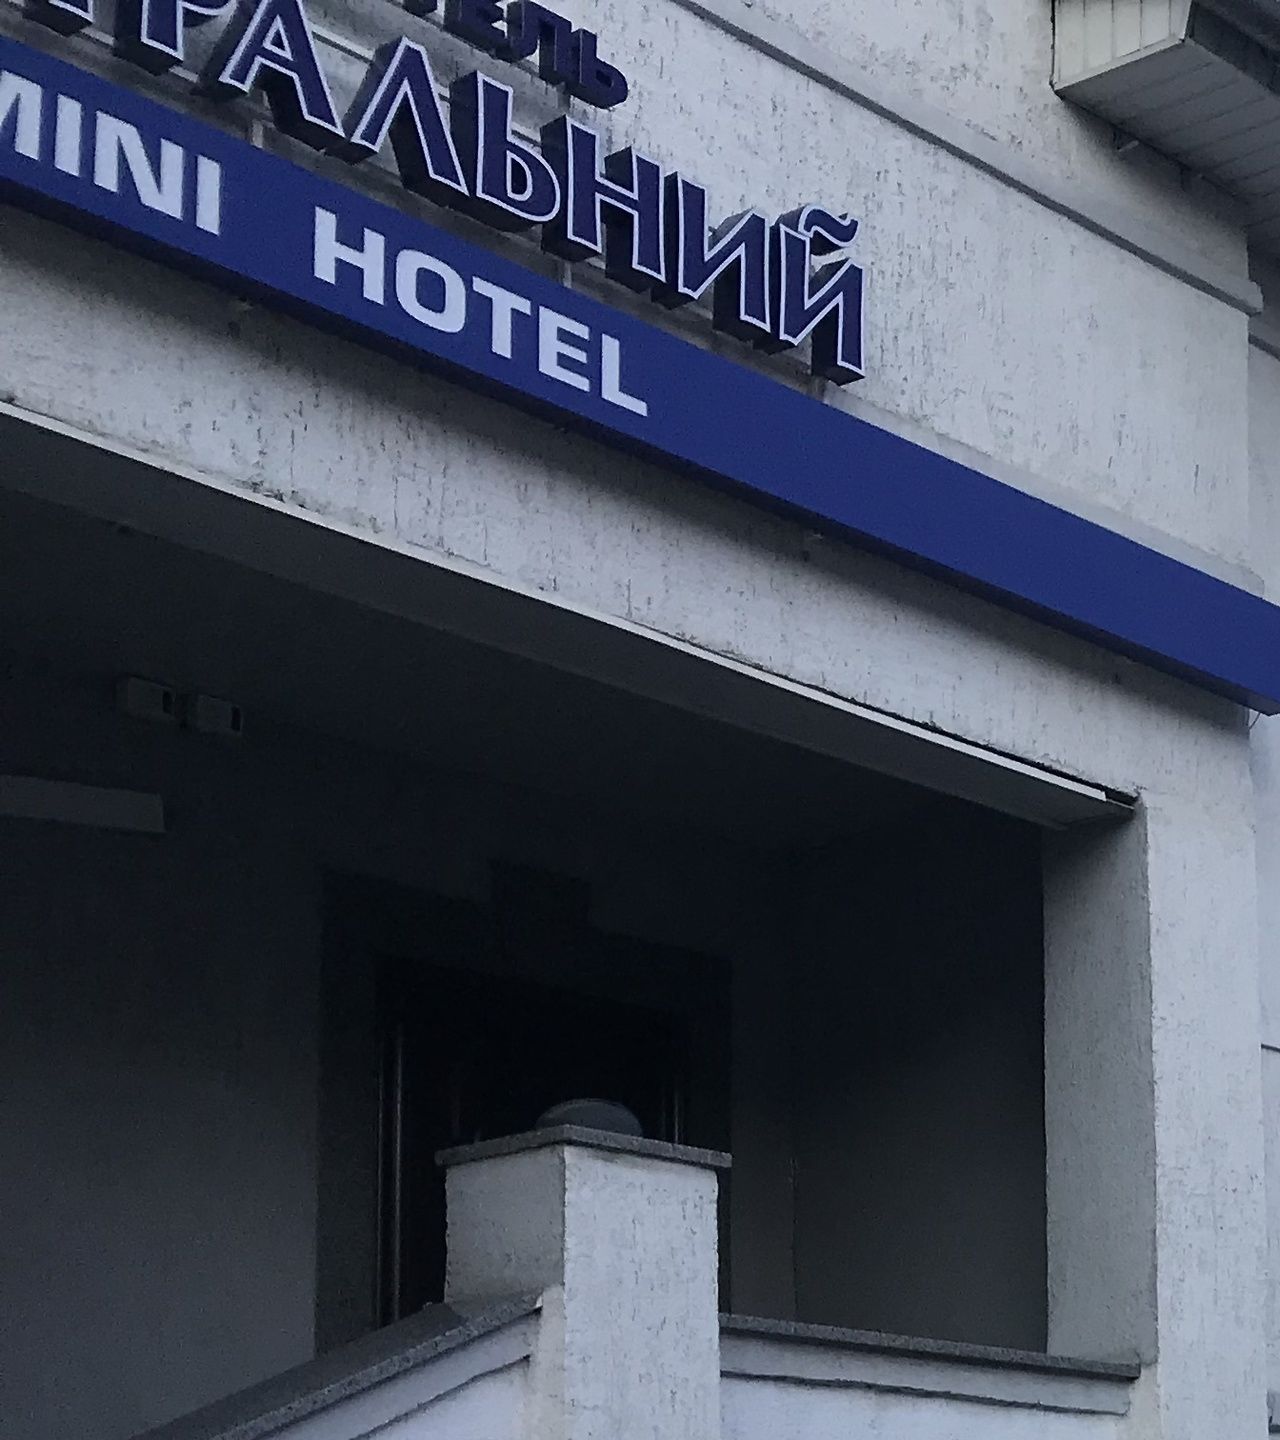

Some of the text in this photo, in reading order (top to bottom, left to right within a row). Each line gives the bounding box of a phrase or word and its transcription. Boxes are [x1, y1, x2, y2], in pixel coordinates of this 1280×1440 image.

[402, 0, 628, 109] ЕЛЬ
[48, 0, 867, 385] АЛЬНИЙ
[313, 206, 649, 417] HOTEL
